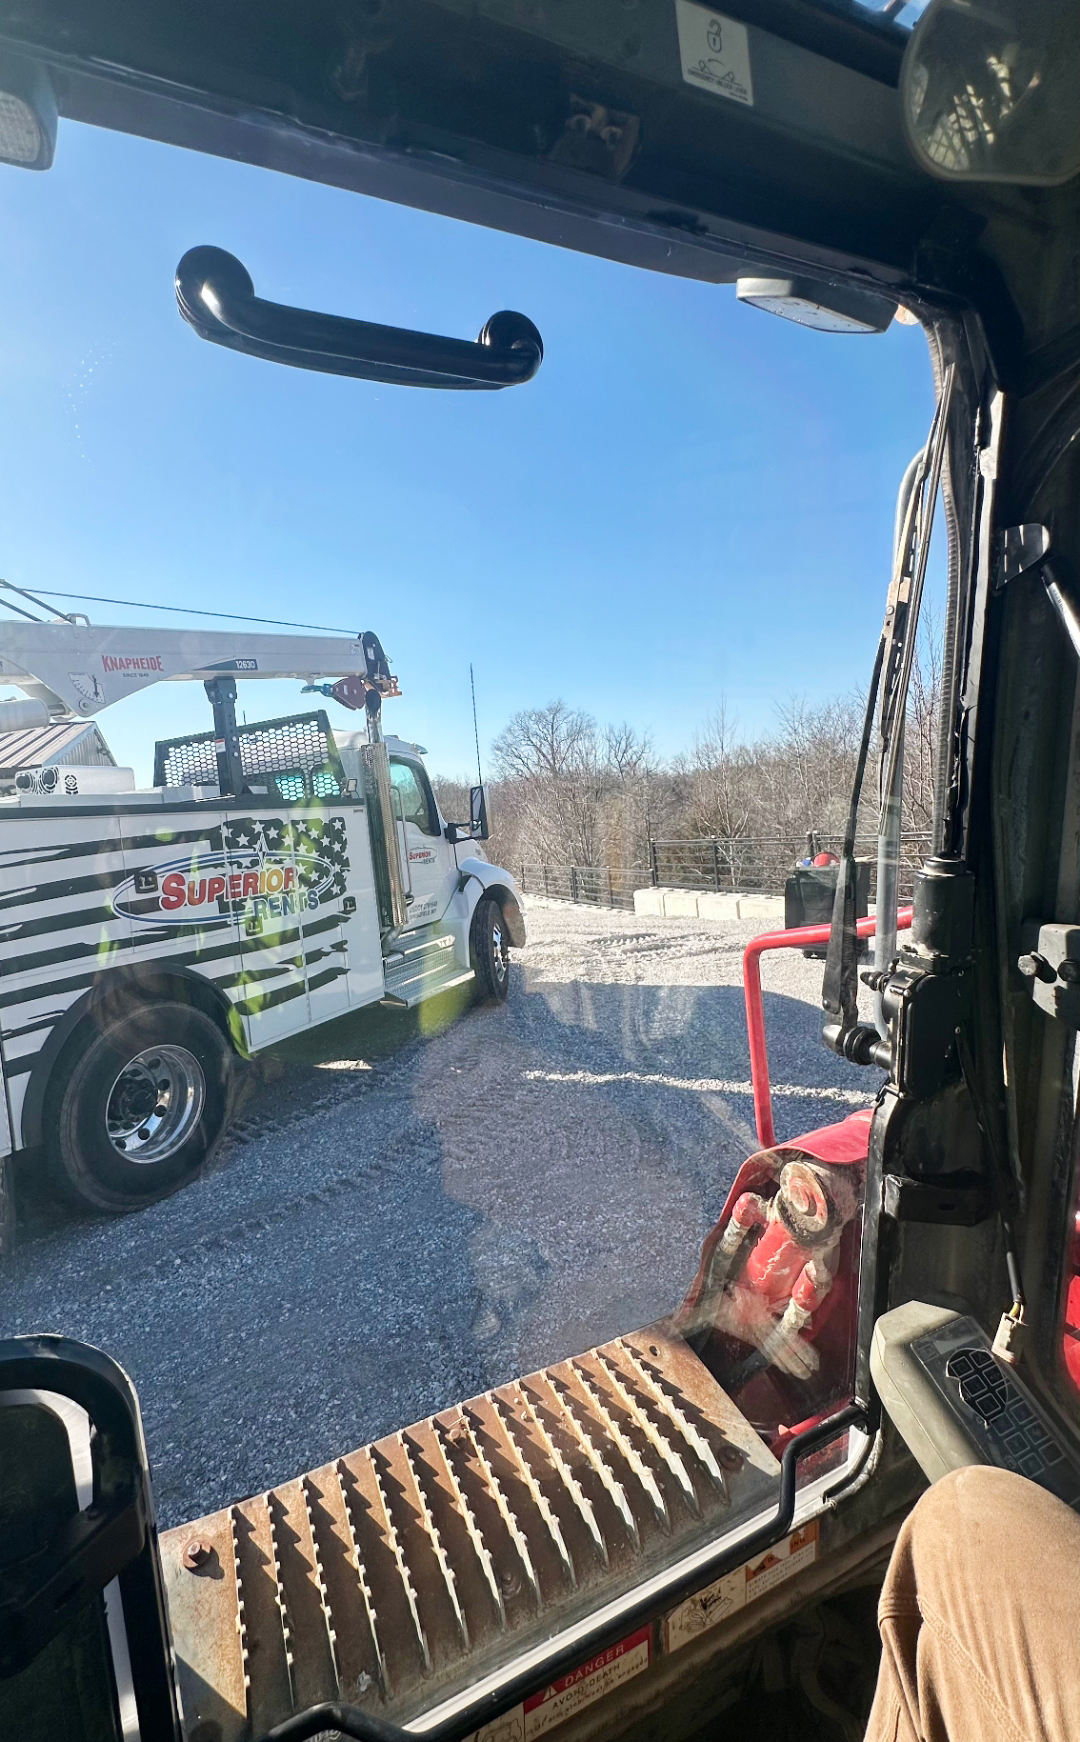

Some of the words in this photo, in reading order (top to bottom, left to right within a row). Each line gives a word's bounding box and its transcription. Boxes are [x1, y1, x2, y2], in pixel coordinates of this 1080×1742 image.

[102, 655, 164, 672] KNAPHEIDE
[235, 660, 255, 669] 12630
[160, 866, 298, 910] SUPERIOR
[253, 890, 320, 920] RENTS
[564, 1644, 624, 1688] DANGER
[552, 1687, 584, 1709] AVOID
[589, 1663, 620, 1688] DEATH
